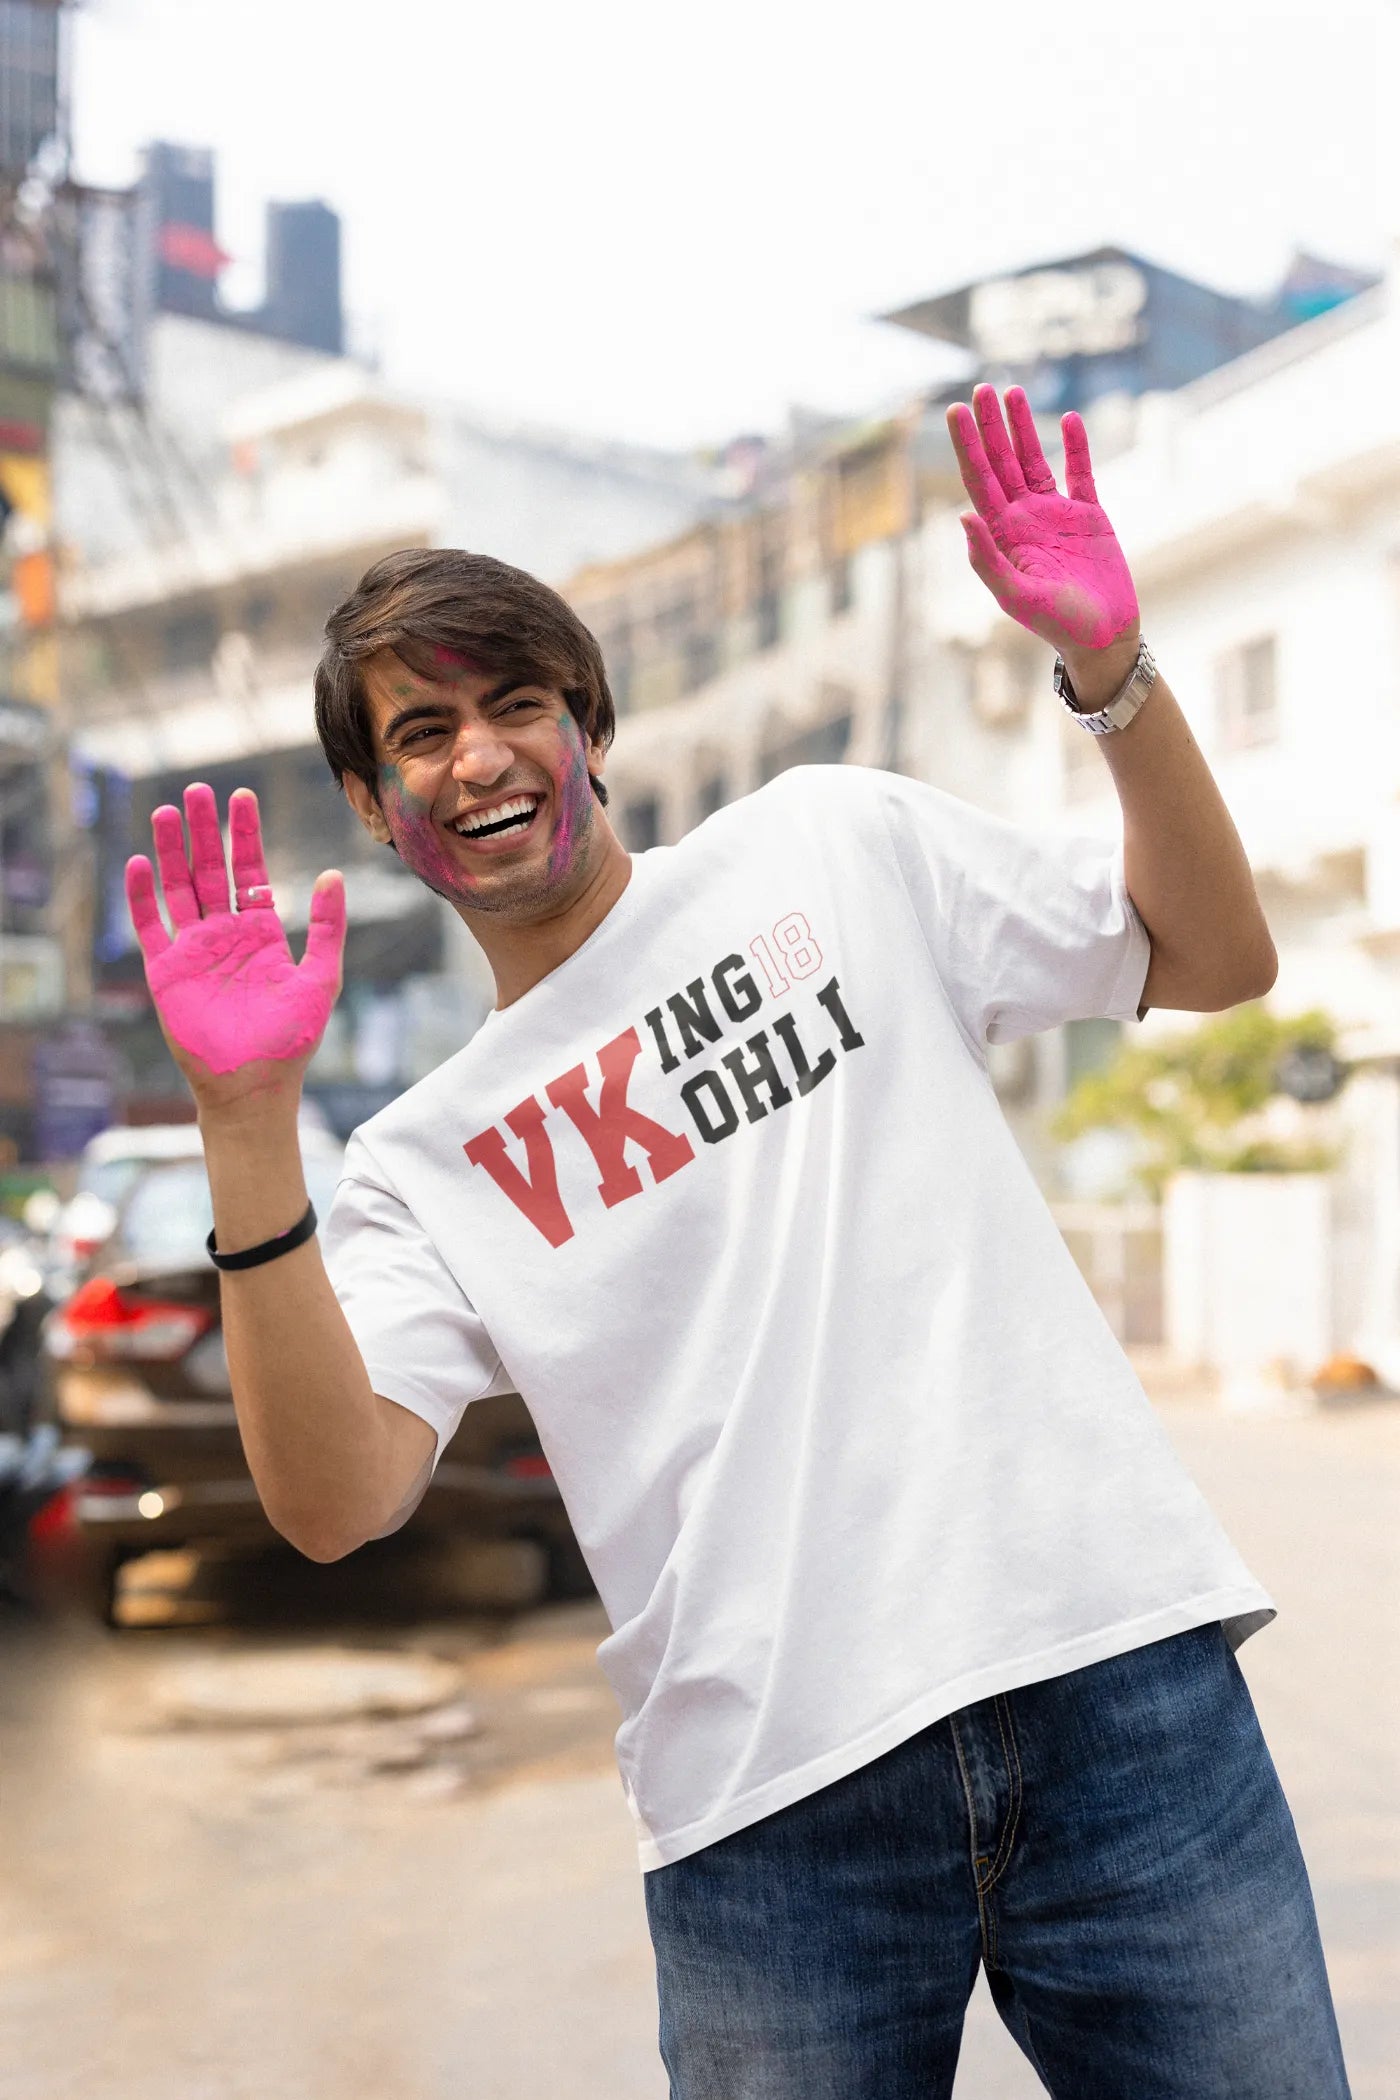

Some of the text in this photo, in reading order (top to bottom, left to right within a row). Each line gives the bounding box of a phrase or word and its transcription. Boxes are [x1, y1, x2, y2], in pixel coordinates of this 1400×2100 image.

[645, 912, 823, 1074] ING 18
[680, 977, 865, 1144] OHLI
[463, 1027, 696, 1249] VK
